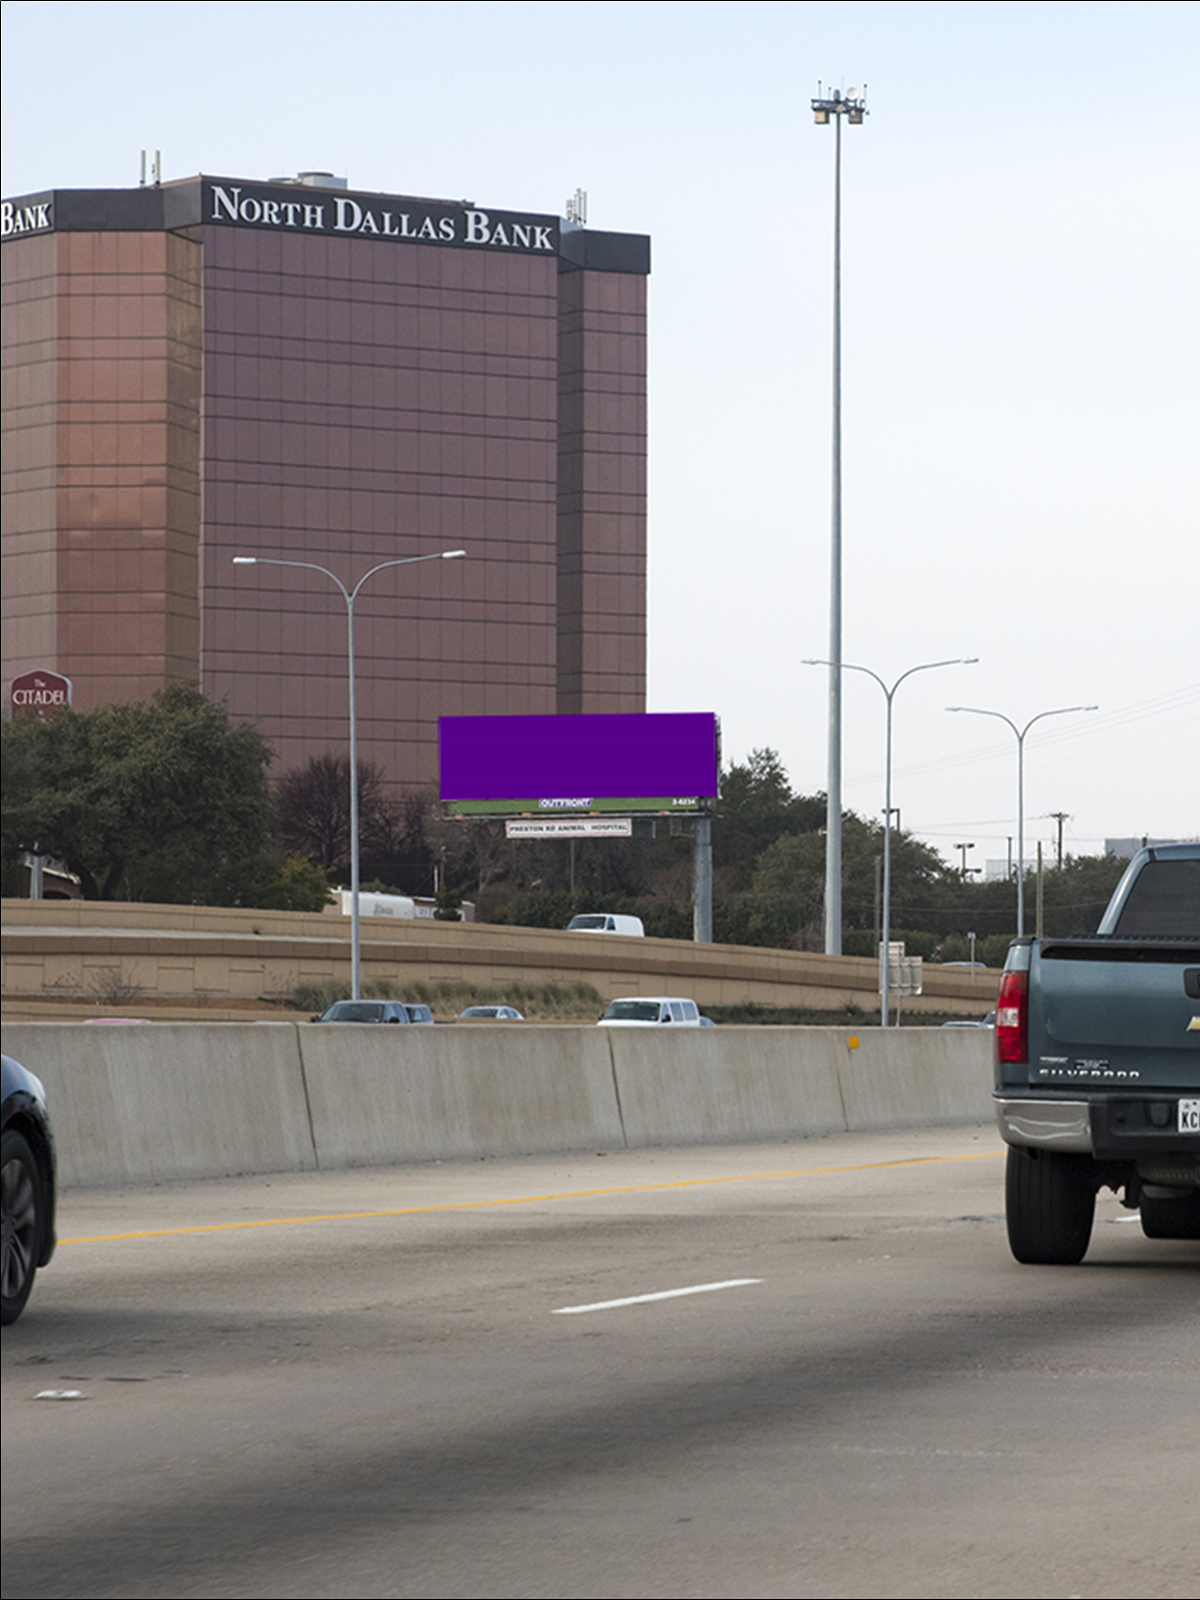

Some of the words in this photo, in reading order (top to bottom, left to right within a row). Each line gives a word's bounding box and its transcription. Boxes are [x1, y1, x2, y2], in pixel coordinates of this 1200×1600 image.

[1, 202, 51, 236] BANK
[211, 186, 325, 229] NORTH
[333, 197, 455, 242] DALLAS
[464, 210, 553, 250] BANK
[540, 798, 591, 808] OUTFRONT
